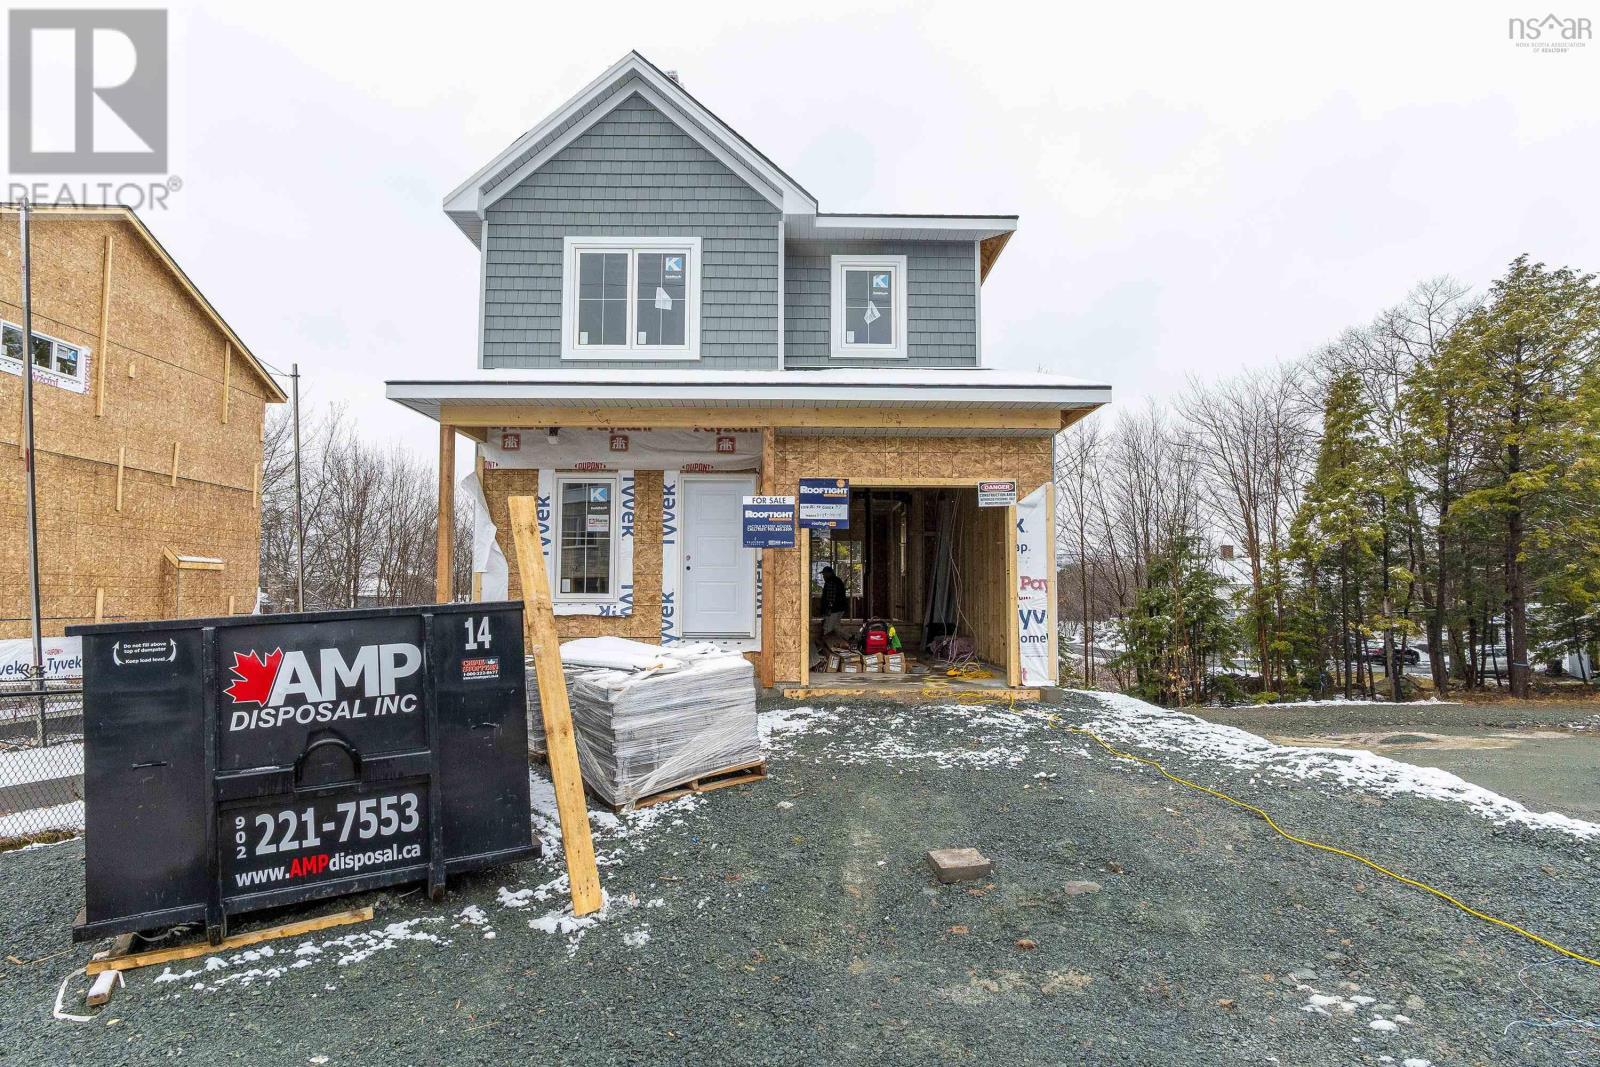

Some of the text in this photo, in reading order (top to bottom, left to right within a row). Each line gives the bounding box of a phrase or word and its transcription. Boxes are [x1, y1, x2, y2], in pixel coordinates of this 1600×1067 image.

[799, 485, 848, 494] ROOFTIGHT
[745, 510, 794, 518] ROOFTIGHT
[464, 616, 492, 650] 14
[47, 655, 82, 674] Tyvek
[267, 642, 422, 708] AMP
[229, 693, 418, 732] DISPOSAL INC
[255, 792, 420, 856] 221-7553
[235, 843, 422, 888] www.AMPdisposal.ca
